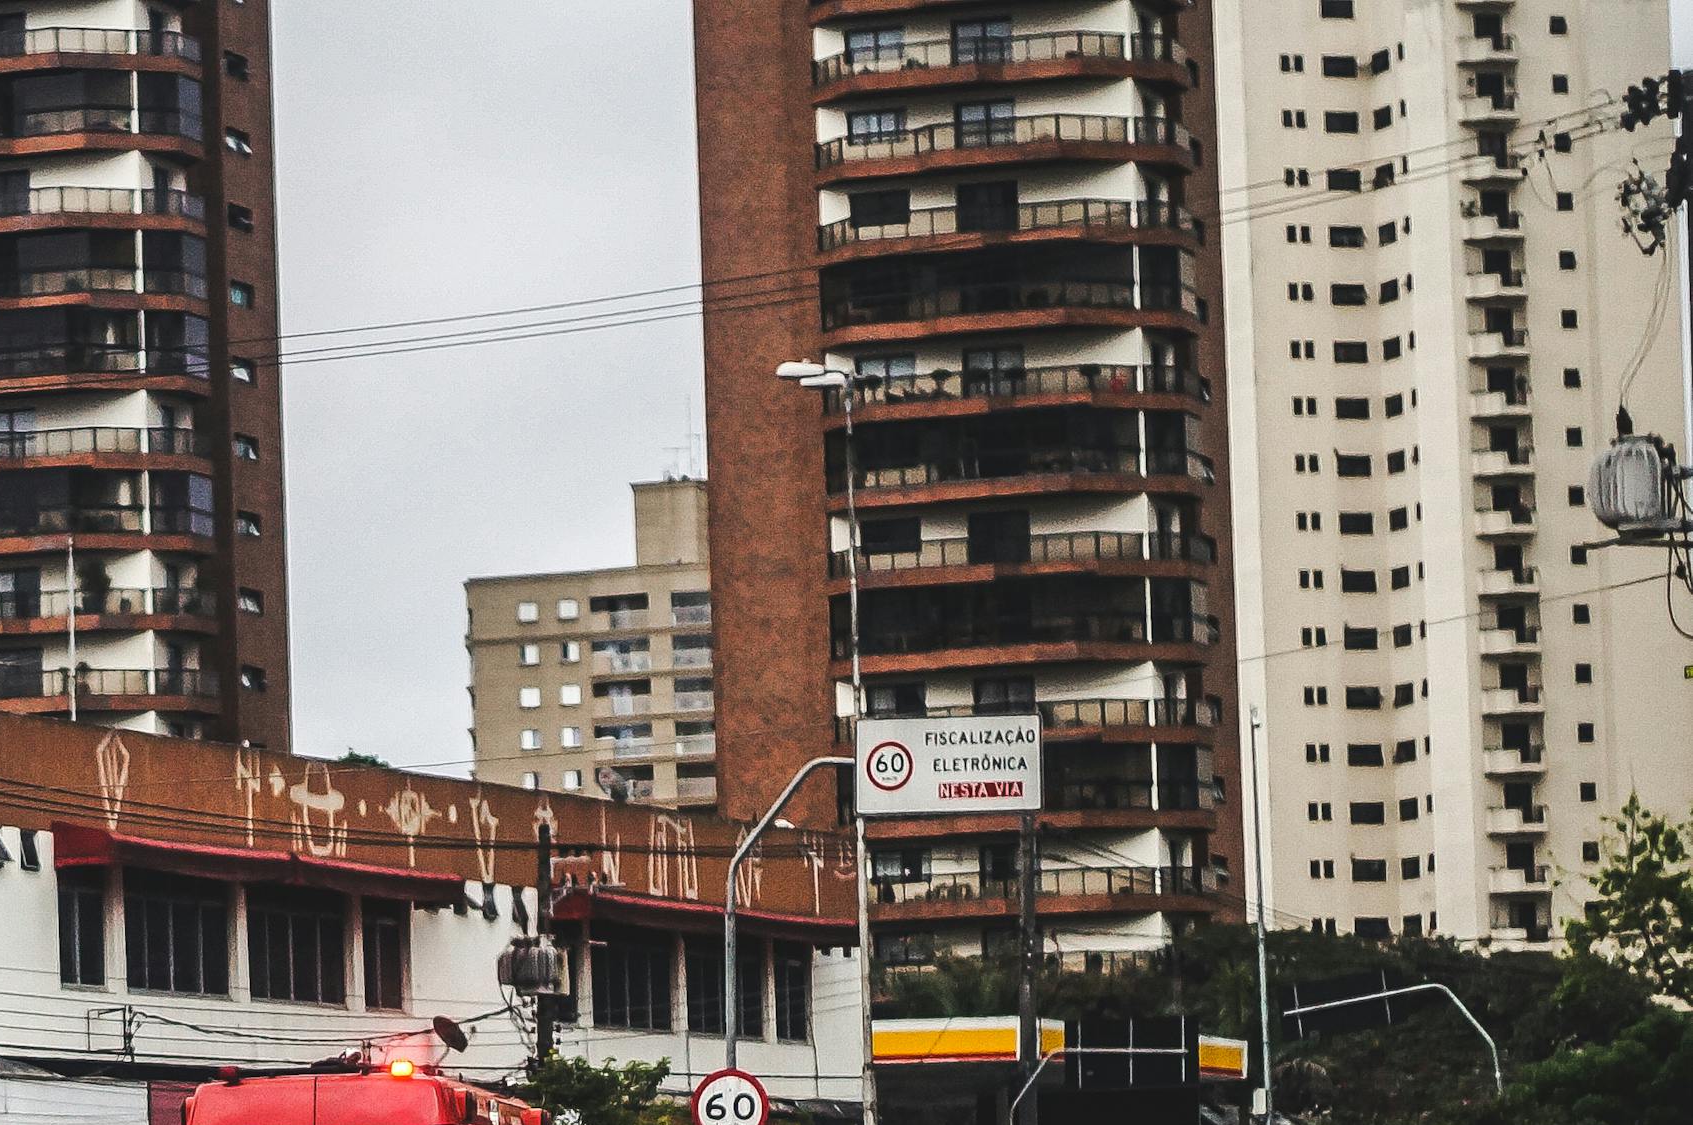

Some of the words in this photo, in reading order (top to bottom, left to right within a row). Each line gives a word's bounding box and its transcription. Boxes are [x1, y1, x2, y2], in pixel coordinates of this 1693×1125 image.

[925, 726, 1035, 747] FISCALIZAÇÃO
[876, 752, 904, 773] 60
[933, 753, 1028, 772] ELETRÔNICA
[939, 782, 990, 798] NESTA
[995, 781, 1023, 797] VIA
[705, 1093, 756, 1120] 60
